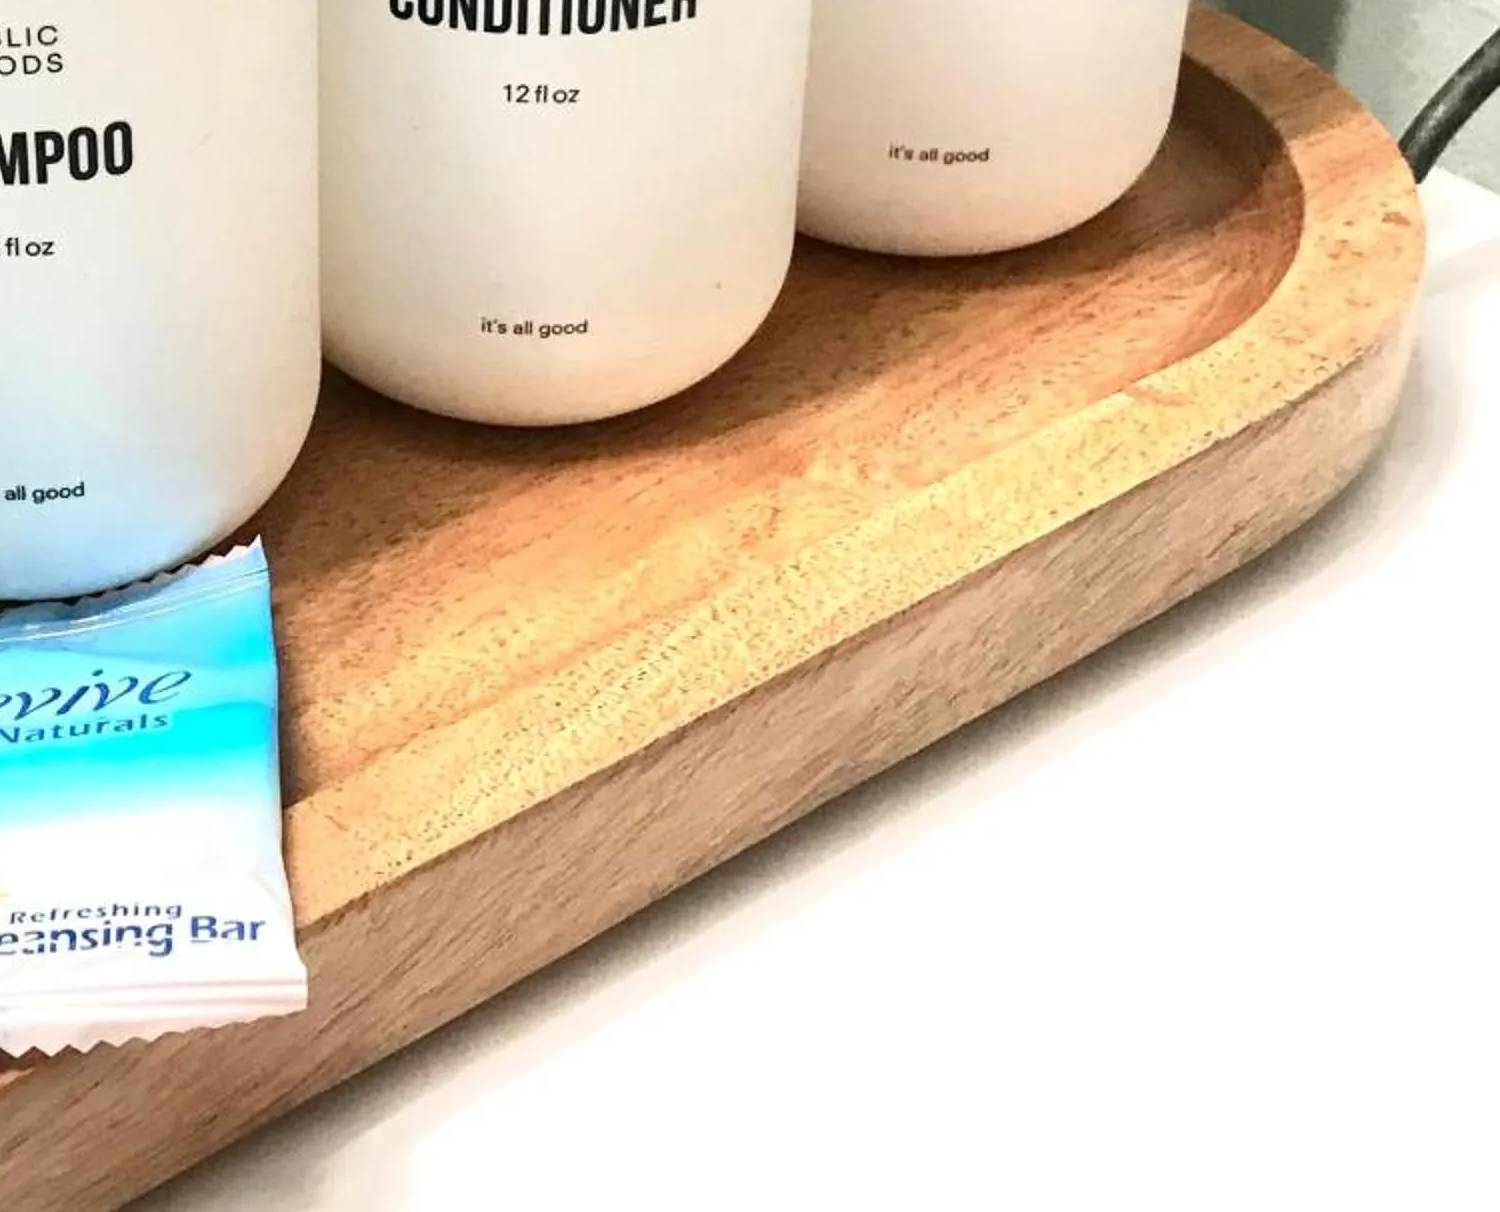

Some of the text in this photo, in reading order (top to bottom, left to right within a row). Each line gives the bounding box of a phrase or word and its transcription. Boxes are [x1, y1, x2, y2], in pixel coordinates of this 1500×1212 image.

[503, 83, 581, 104] 12 fl oz
[888, 146, 990, 166] it's all good
[4, 237, 20, 257] fl
[25, 241, 55, 257] oz
[481, 317, 589, 339] it's all good
[4, 485, 27, 501] all
[31, 481, 85, 505] good
[8, 903, 183, 926] Refreshing
[190, 914, 267, 944] Bar
